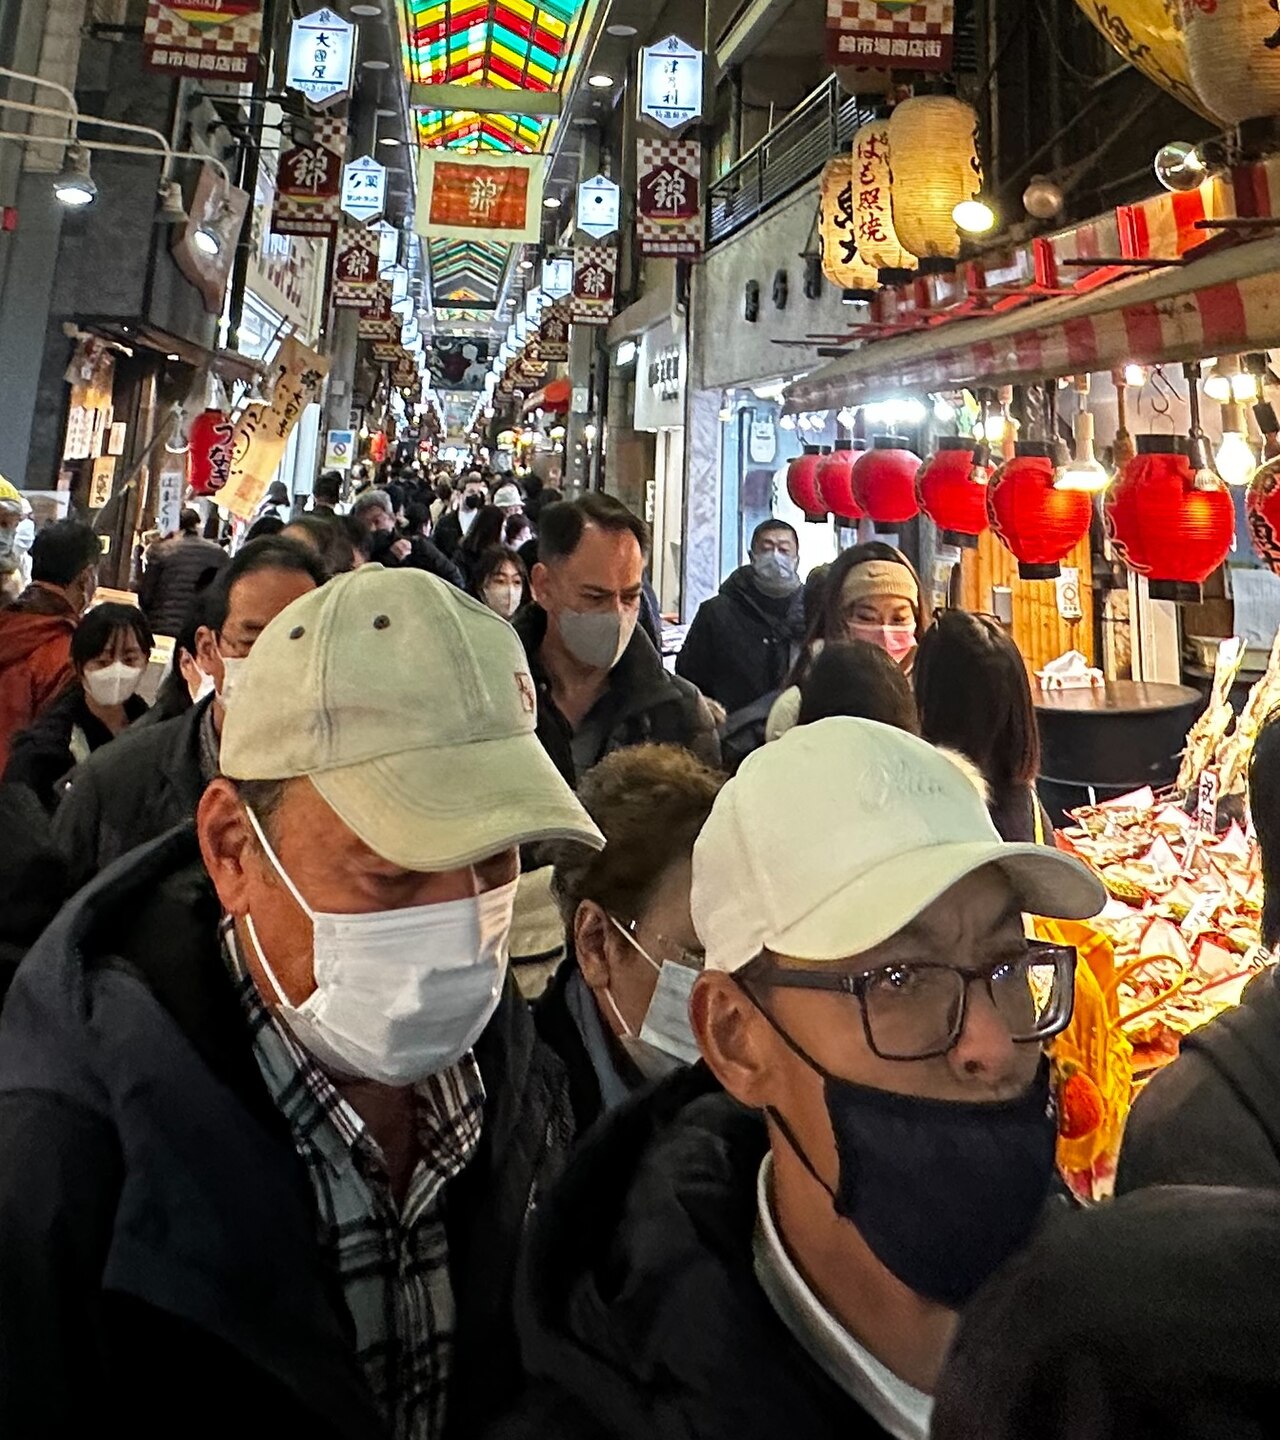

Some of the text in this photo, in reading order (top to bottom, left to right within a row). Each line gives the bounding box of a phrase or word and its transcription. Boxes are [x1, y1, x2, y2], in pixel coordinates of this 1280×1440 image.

[838, 35, 943, 58] 錦市場商店街
[288, 147, 328, 195] 錦
[647, 169, 686, 217] 錦
